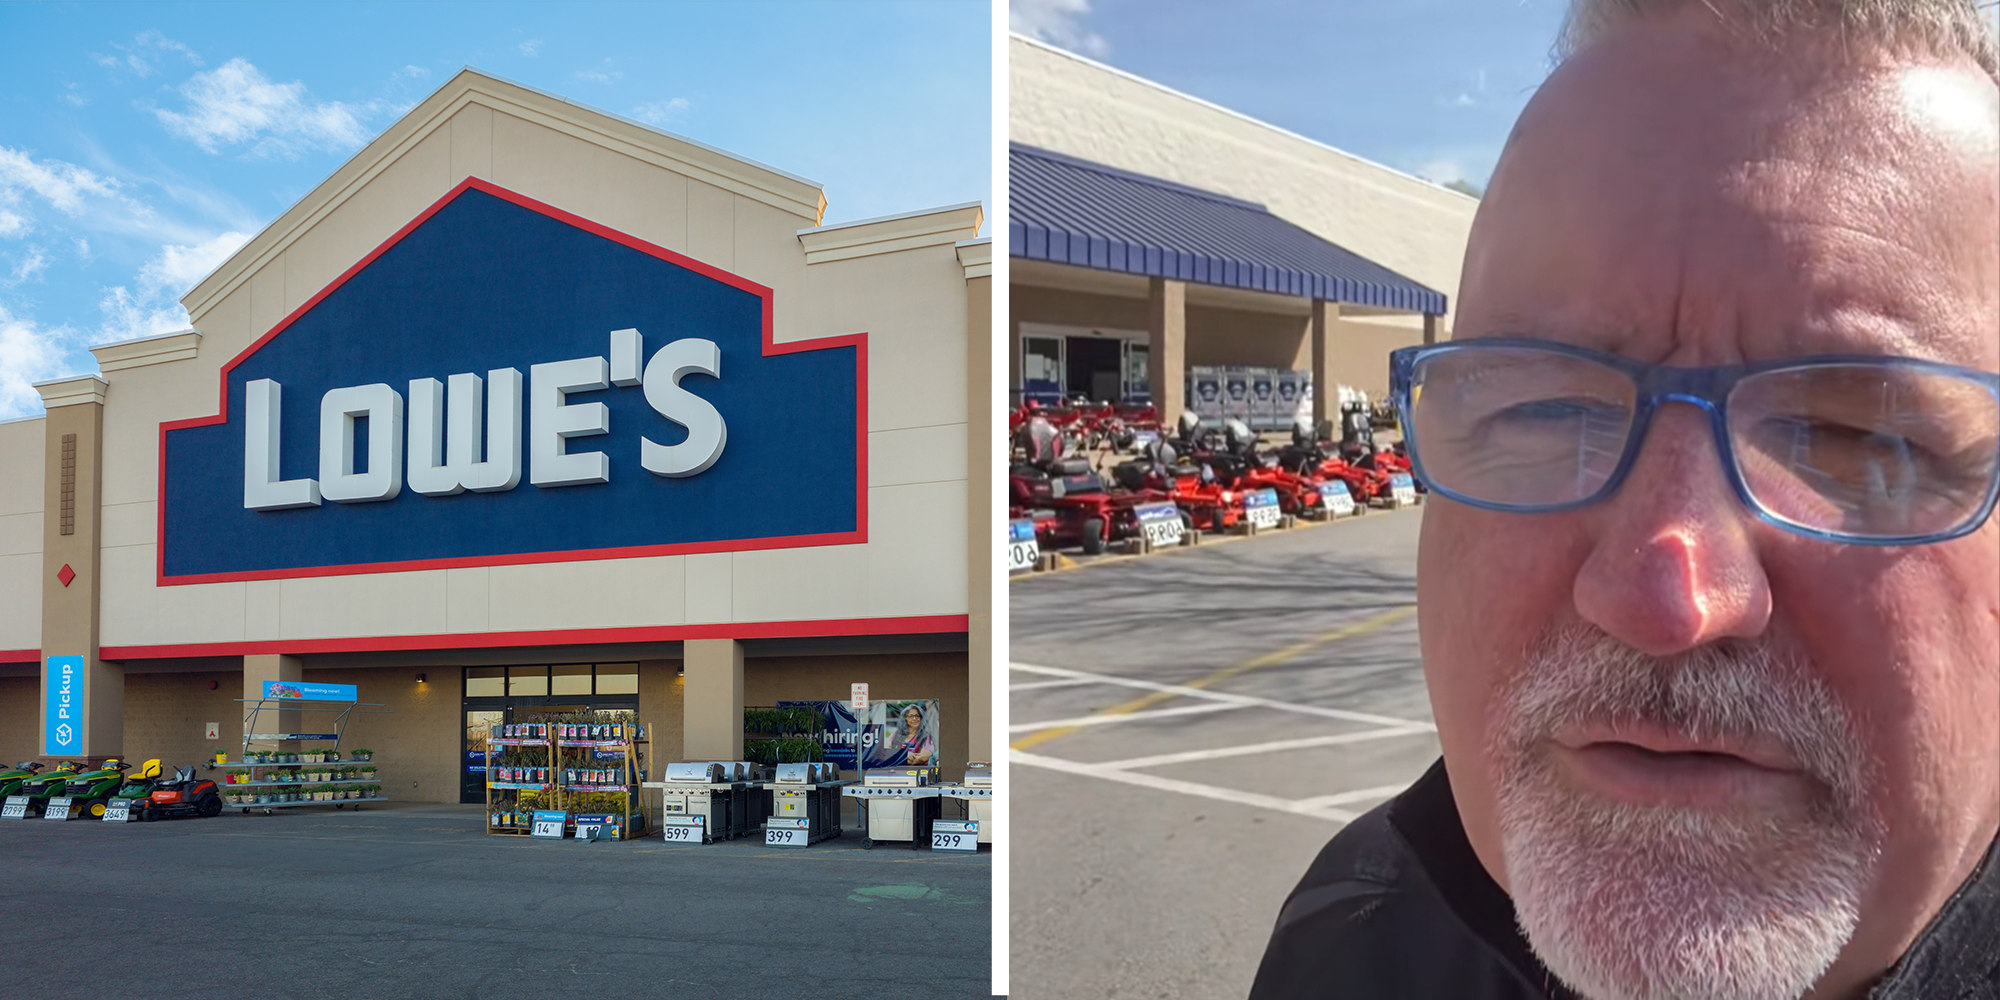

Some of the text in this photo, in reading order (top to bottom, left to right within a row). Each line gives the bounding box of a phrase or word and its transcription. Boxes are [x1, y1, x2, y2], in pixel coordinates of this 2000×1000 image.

[244, 328, 727, 512] LOWE'S
[58, 664, 73, 719] Pickup
[823, 728, 879, 747] hiring!
[3, 806, 23, 815] 2799
[47, 807, 65, 816] 3199
[104, 809, 126, 819] 3649
[537, 823, 549, 834] 14
[667, 828, 689, 839] 599
[768, 831, 793, 842] 399
[934, 834, 961, 847] 299
